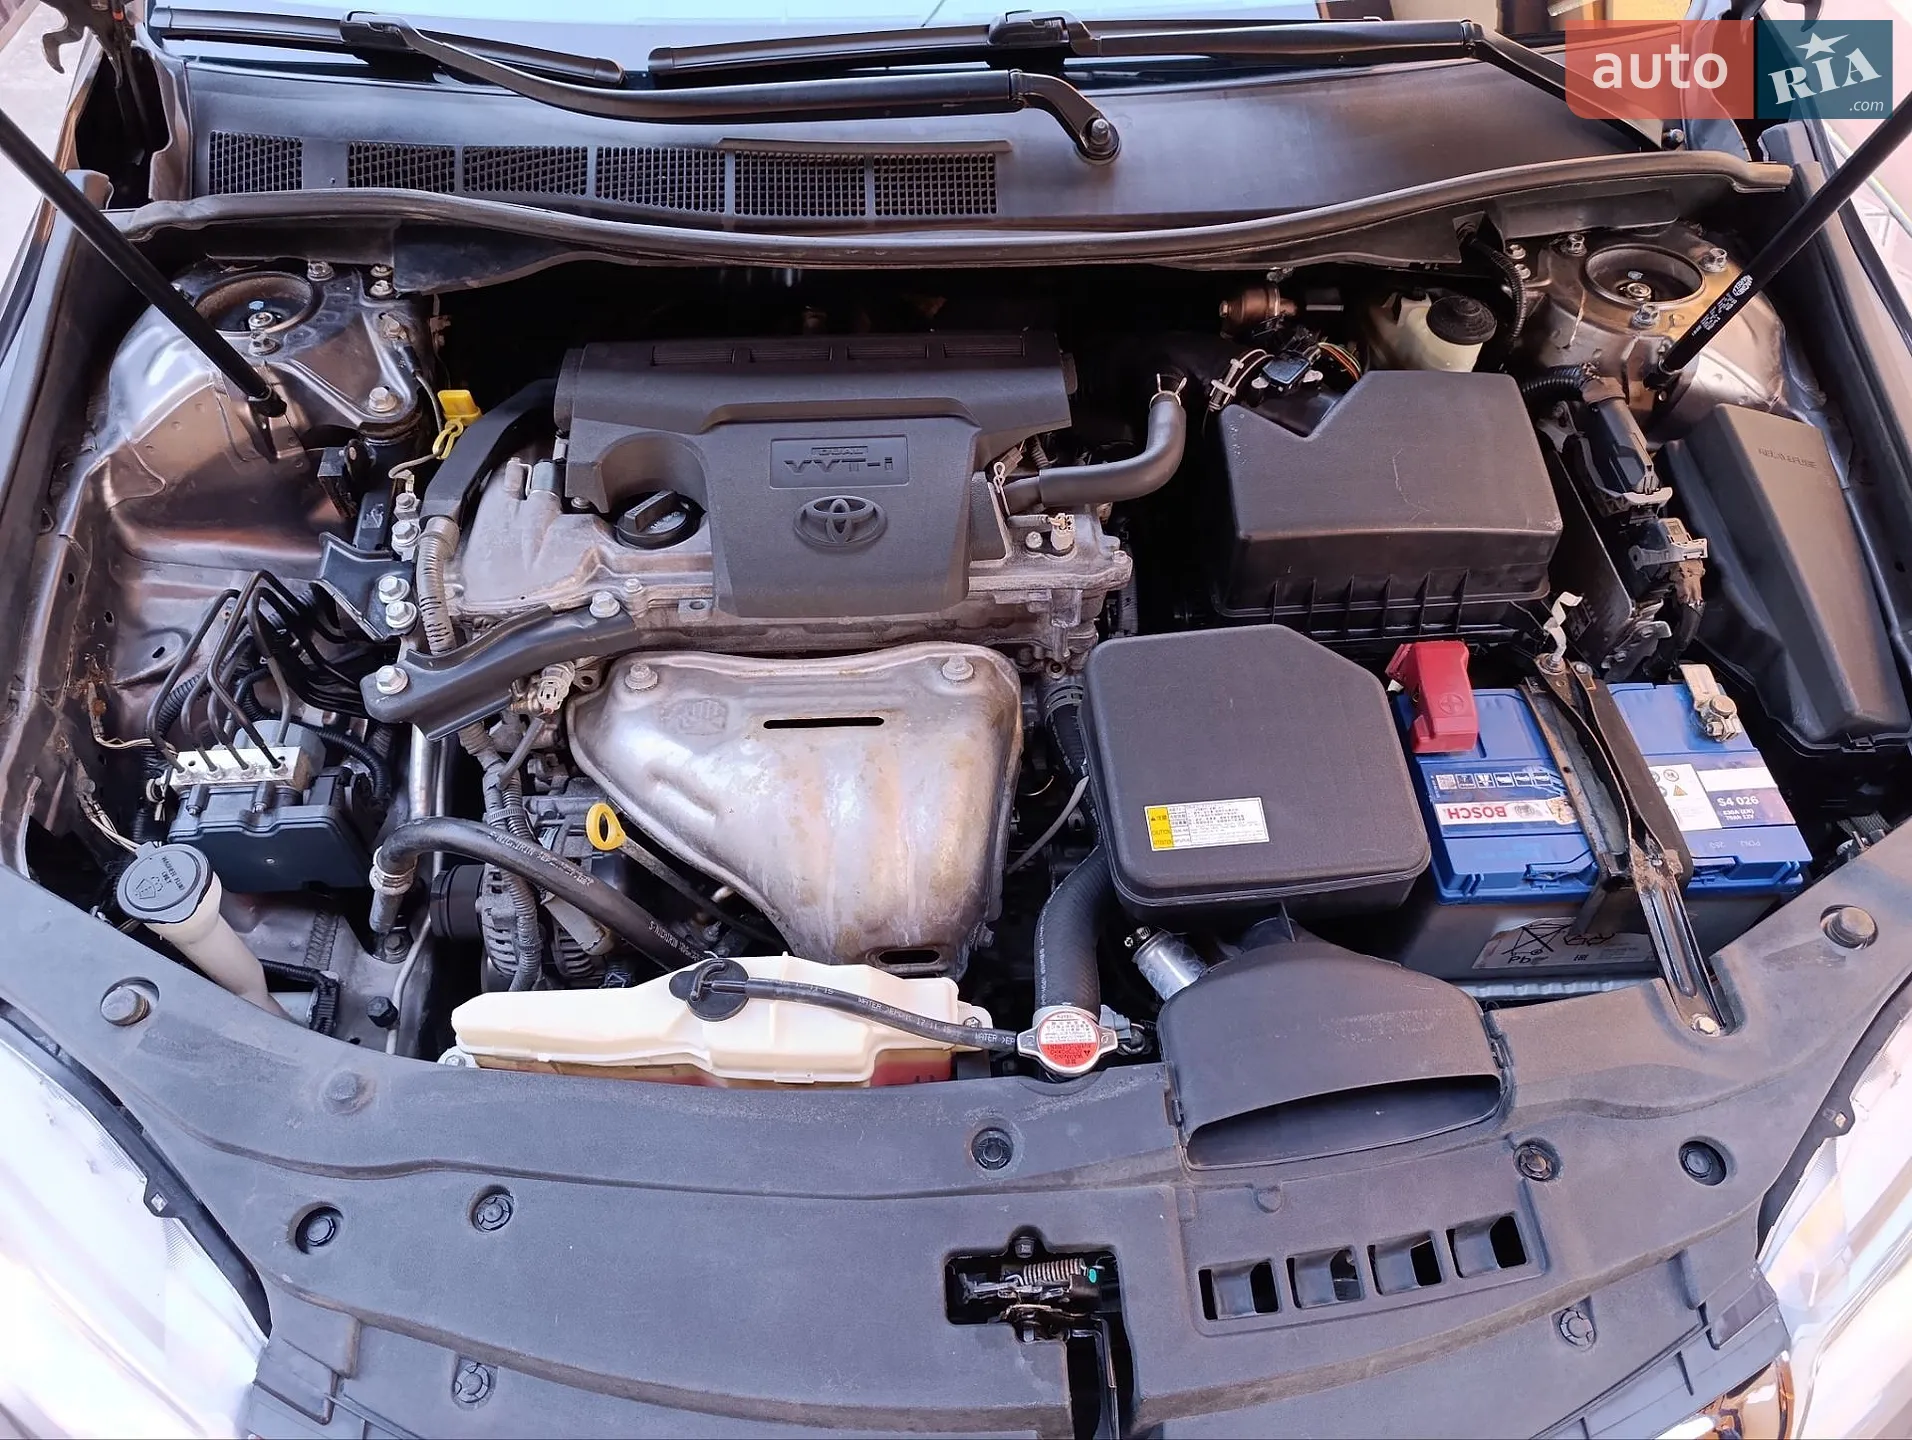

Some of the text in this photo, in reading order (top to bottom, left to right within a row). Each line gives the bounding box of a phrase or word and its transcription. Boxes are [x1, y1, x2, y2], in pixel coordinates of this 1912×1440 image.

[1717, 796, 1759, 806] S4 026
[1447, 806, 1507, 819] BOSCH
[1508, 955, 1531, 964] Pb
[858, 998, 882, 1010] WATER
[975, 1033, 998, 1043] WATER
